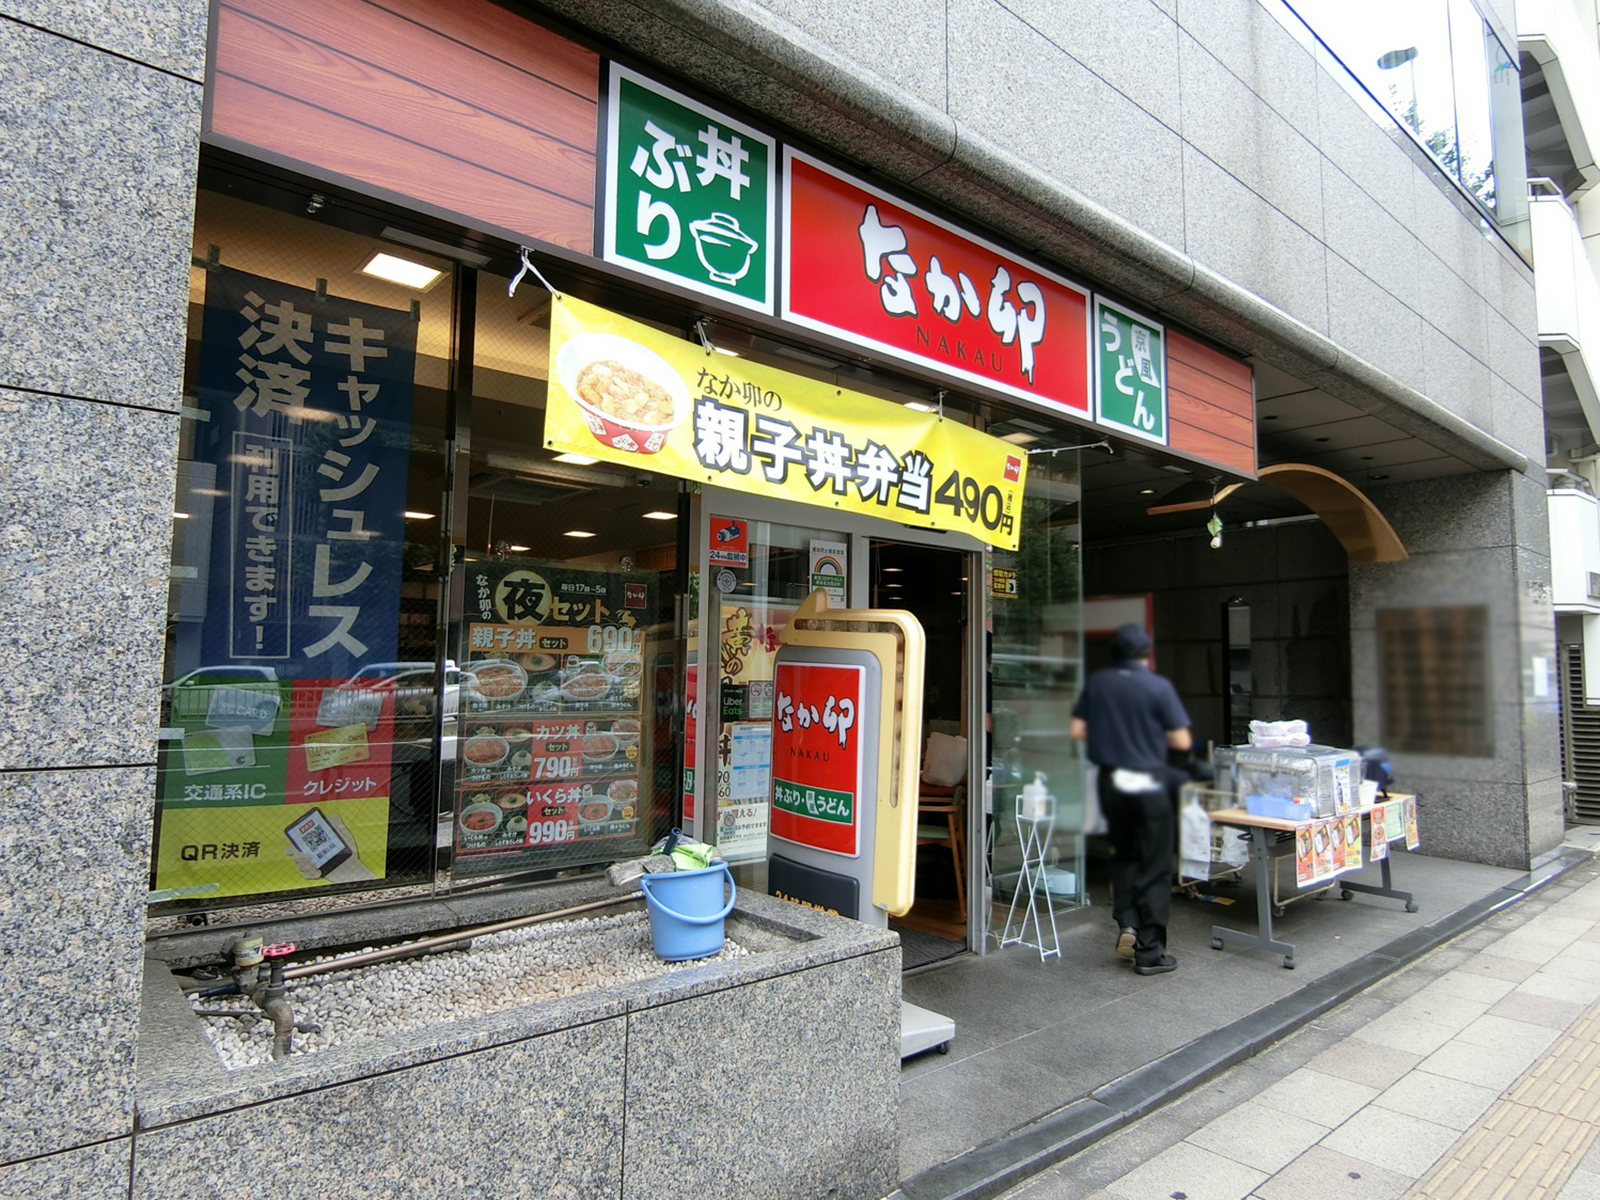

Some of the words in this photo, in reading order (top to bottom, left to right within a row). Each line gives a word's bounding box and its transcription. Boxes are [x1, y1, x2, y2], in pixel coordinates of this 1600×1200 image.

[858, 203, 1046, 386] なか卯
[233, 290, 315, 425] 決済
[916, 324, 1003, 372] NAKAU
[1101, 311, 1155, 431] うどん
[696, 366, 783, 412] なか卯の
[692, 397, 934, 514] 親子丼弁当
[934, 469, 1014, 536] 490円
[302, 317, 388, 659] キャッシュレス
[476, 574, 492, 620] なか卯の
[472, 626, 536, 649] 親子丼
[541, 639, 567, 648] セット
[723, 697, 743, 706] Uber
[723, 706, 743, 715] Eats
[776, 690, 855, 750] なか卯
[536, 724, 582, 741] カツ丼
[547, 743, 568, 751] セット
[789, 747, 830, 762] NAKAU
[184, 784, 267, 801] 交通系IC
[303, 776, 377, 796] クレジット
[527, 788, 582, 806] いくら丼
[544, 808, 566, 816] セット
[181, 841, 260, 861] QR決済
